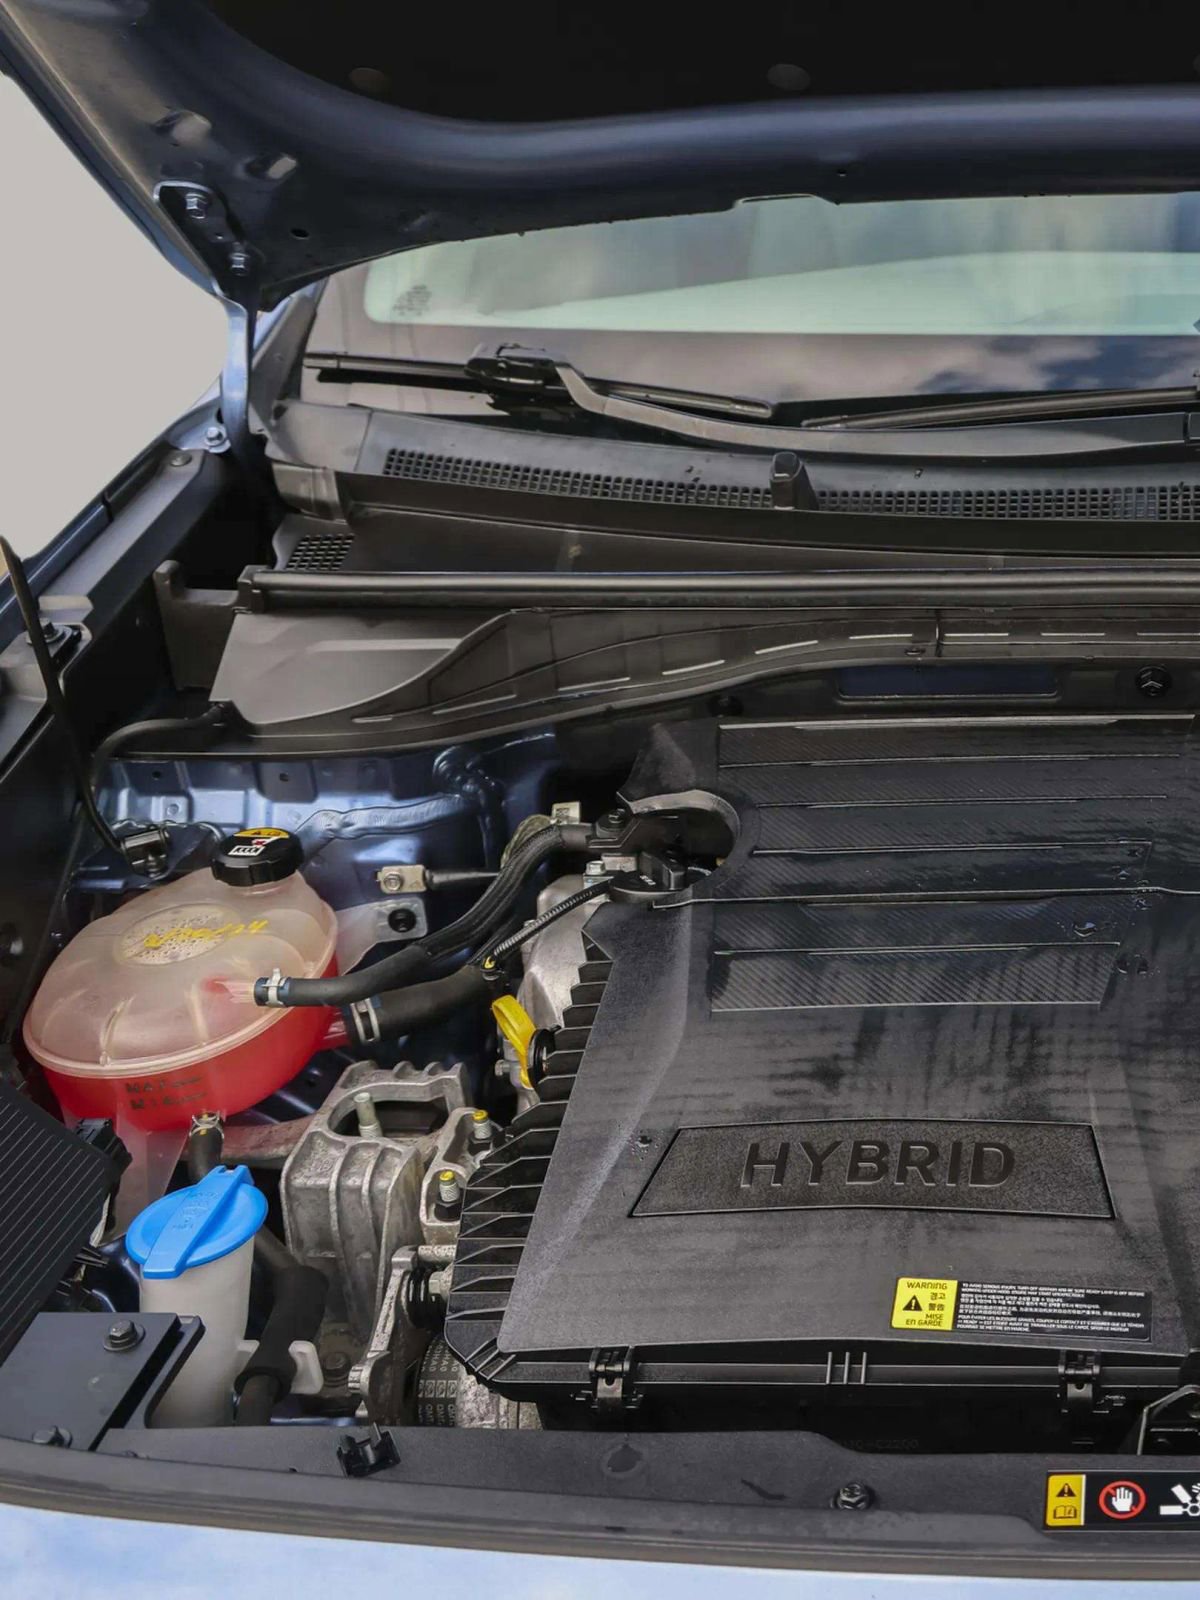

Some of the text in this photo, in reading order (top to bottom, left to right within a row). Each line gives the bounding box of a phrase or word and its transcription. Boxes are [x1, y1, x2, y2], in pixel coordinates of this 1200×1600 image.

[740, 1139, 1016, 1188] HYBRID
[906, 1282, 948, 1290] WARNING
[918, 1319, 944, 1327] GARDE
